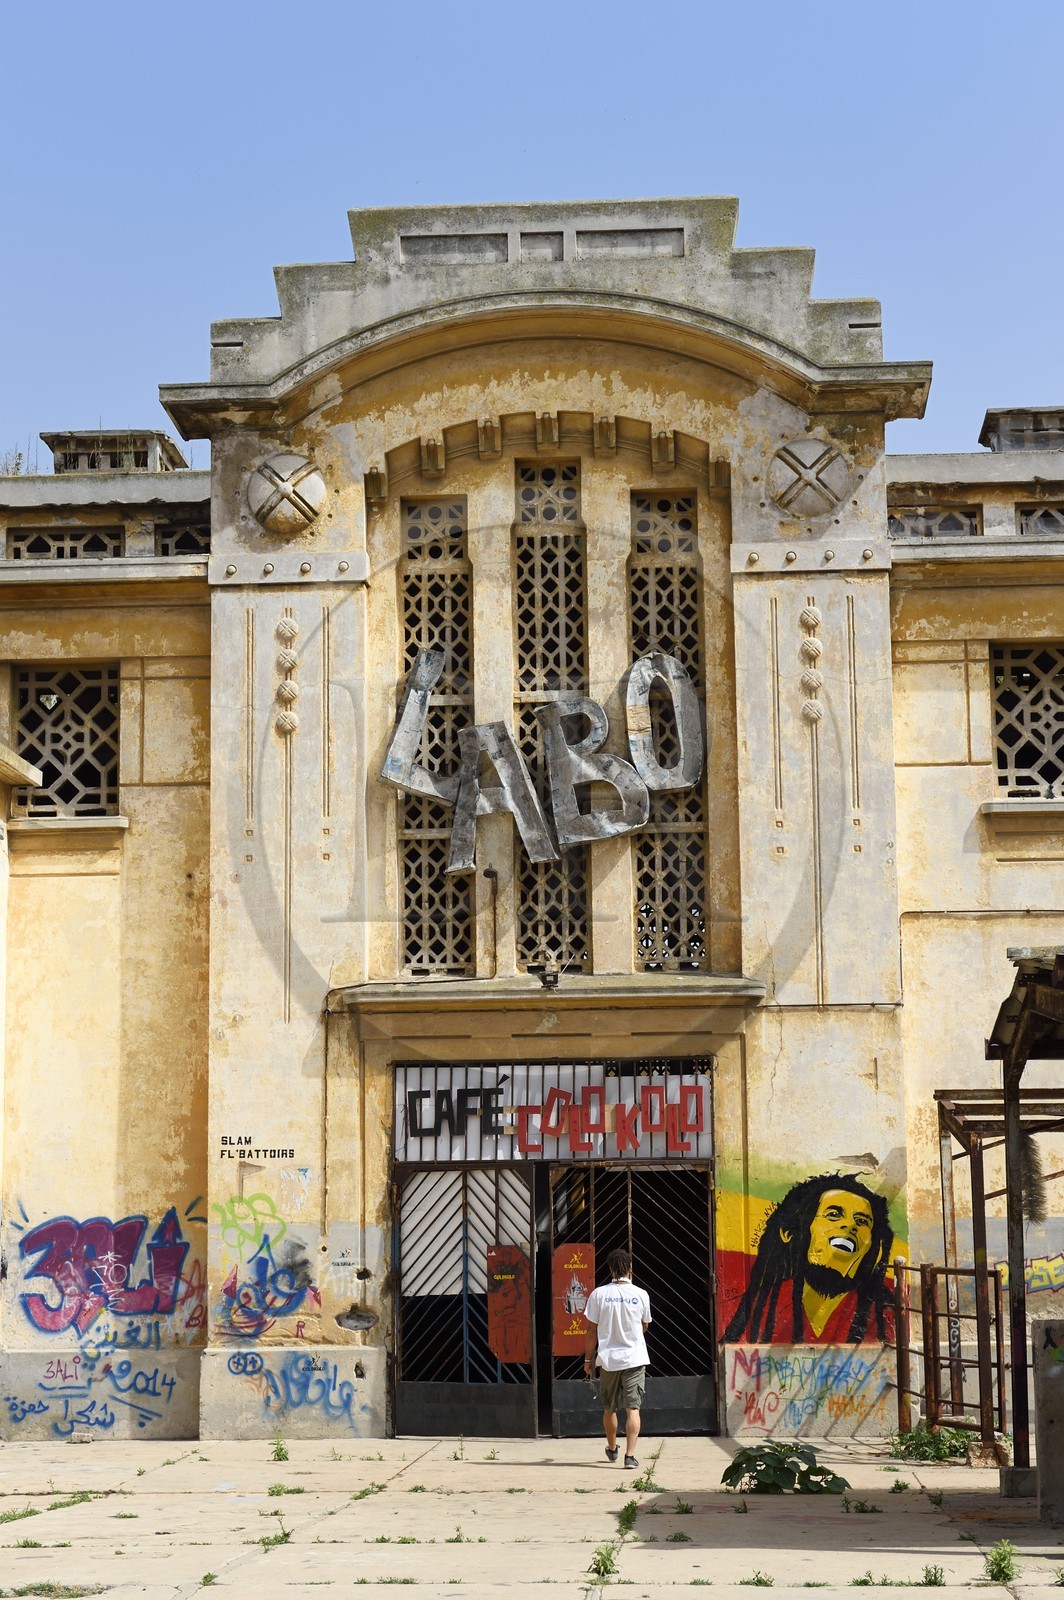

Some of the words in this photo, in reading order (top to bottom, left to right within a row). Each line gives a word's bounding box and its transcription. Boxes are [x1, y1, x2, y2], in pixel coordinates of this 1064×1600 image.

[376, 648, 705, 876] LABO
[408, 1073, 510, 1137] CAFÉ
[518, 1085, 703, 1152] COLOKOLO
[220, 1149, 295, 1159] FL'BATTOIRS
[221, 1136, 252, 1145] SLAM
